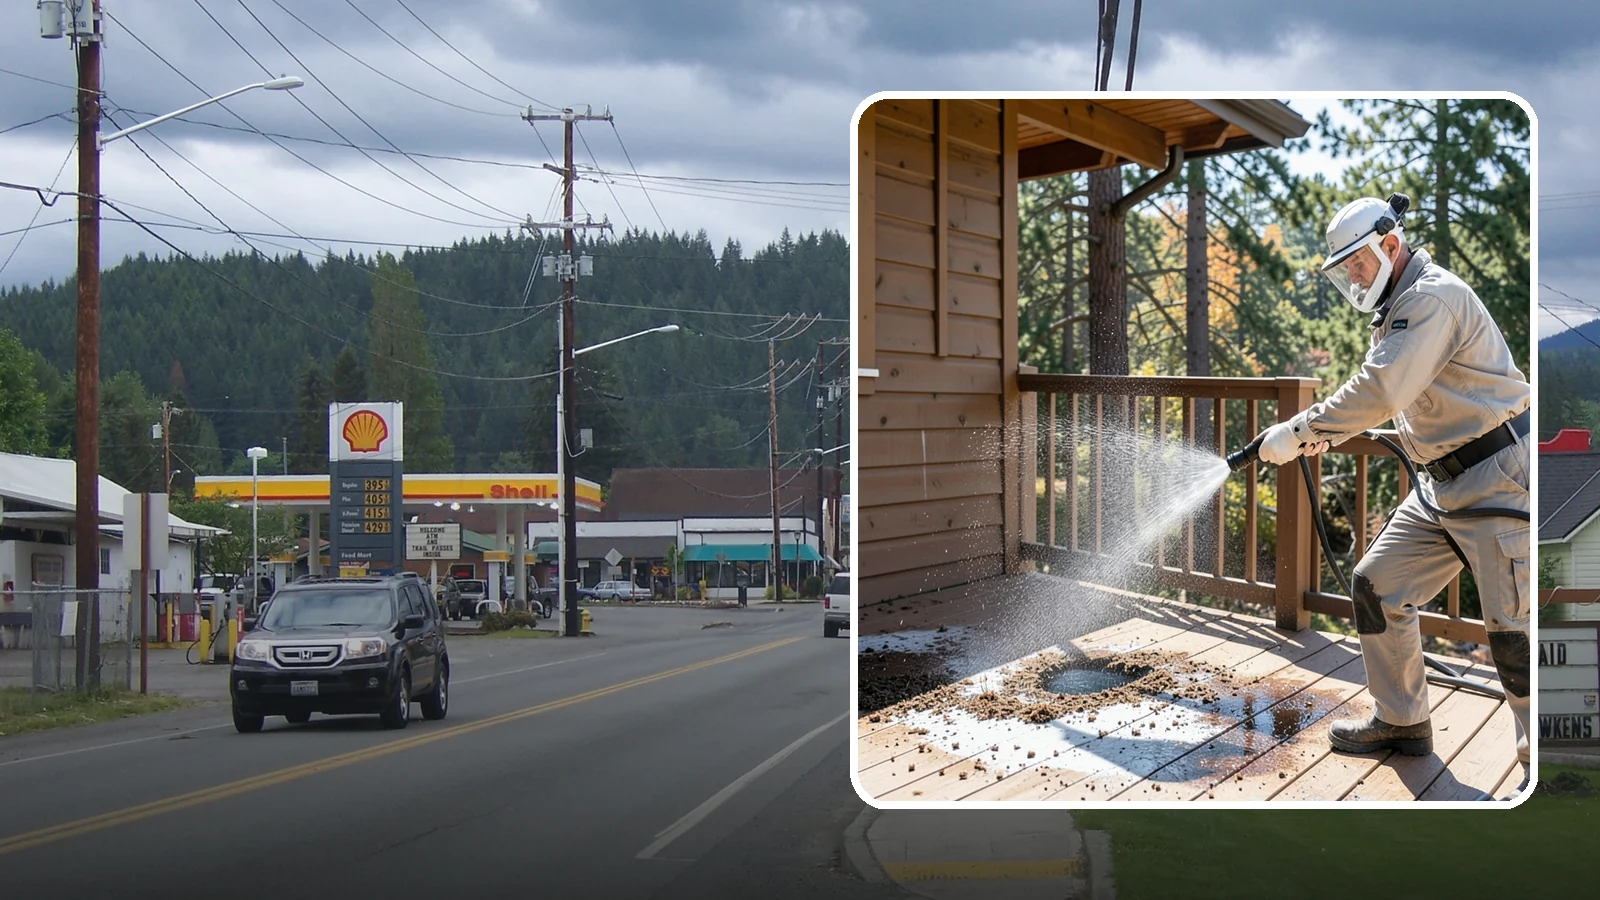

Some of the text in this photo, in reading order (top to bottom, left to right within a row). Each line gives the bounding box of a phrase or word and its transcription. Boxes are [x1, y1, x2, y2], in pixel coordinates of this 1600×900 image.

[366, 480, 383, 490] 395
[490, 484, 547, 499] Shell
[366, 494, 383, 504] 405
[366, 508, 383, 518] 415
[366, 522, 383, 532] 429
[1539, 643, 1567, 665] AID
